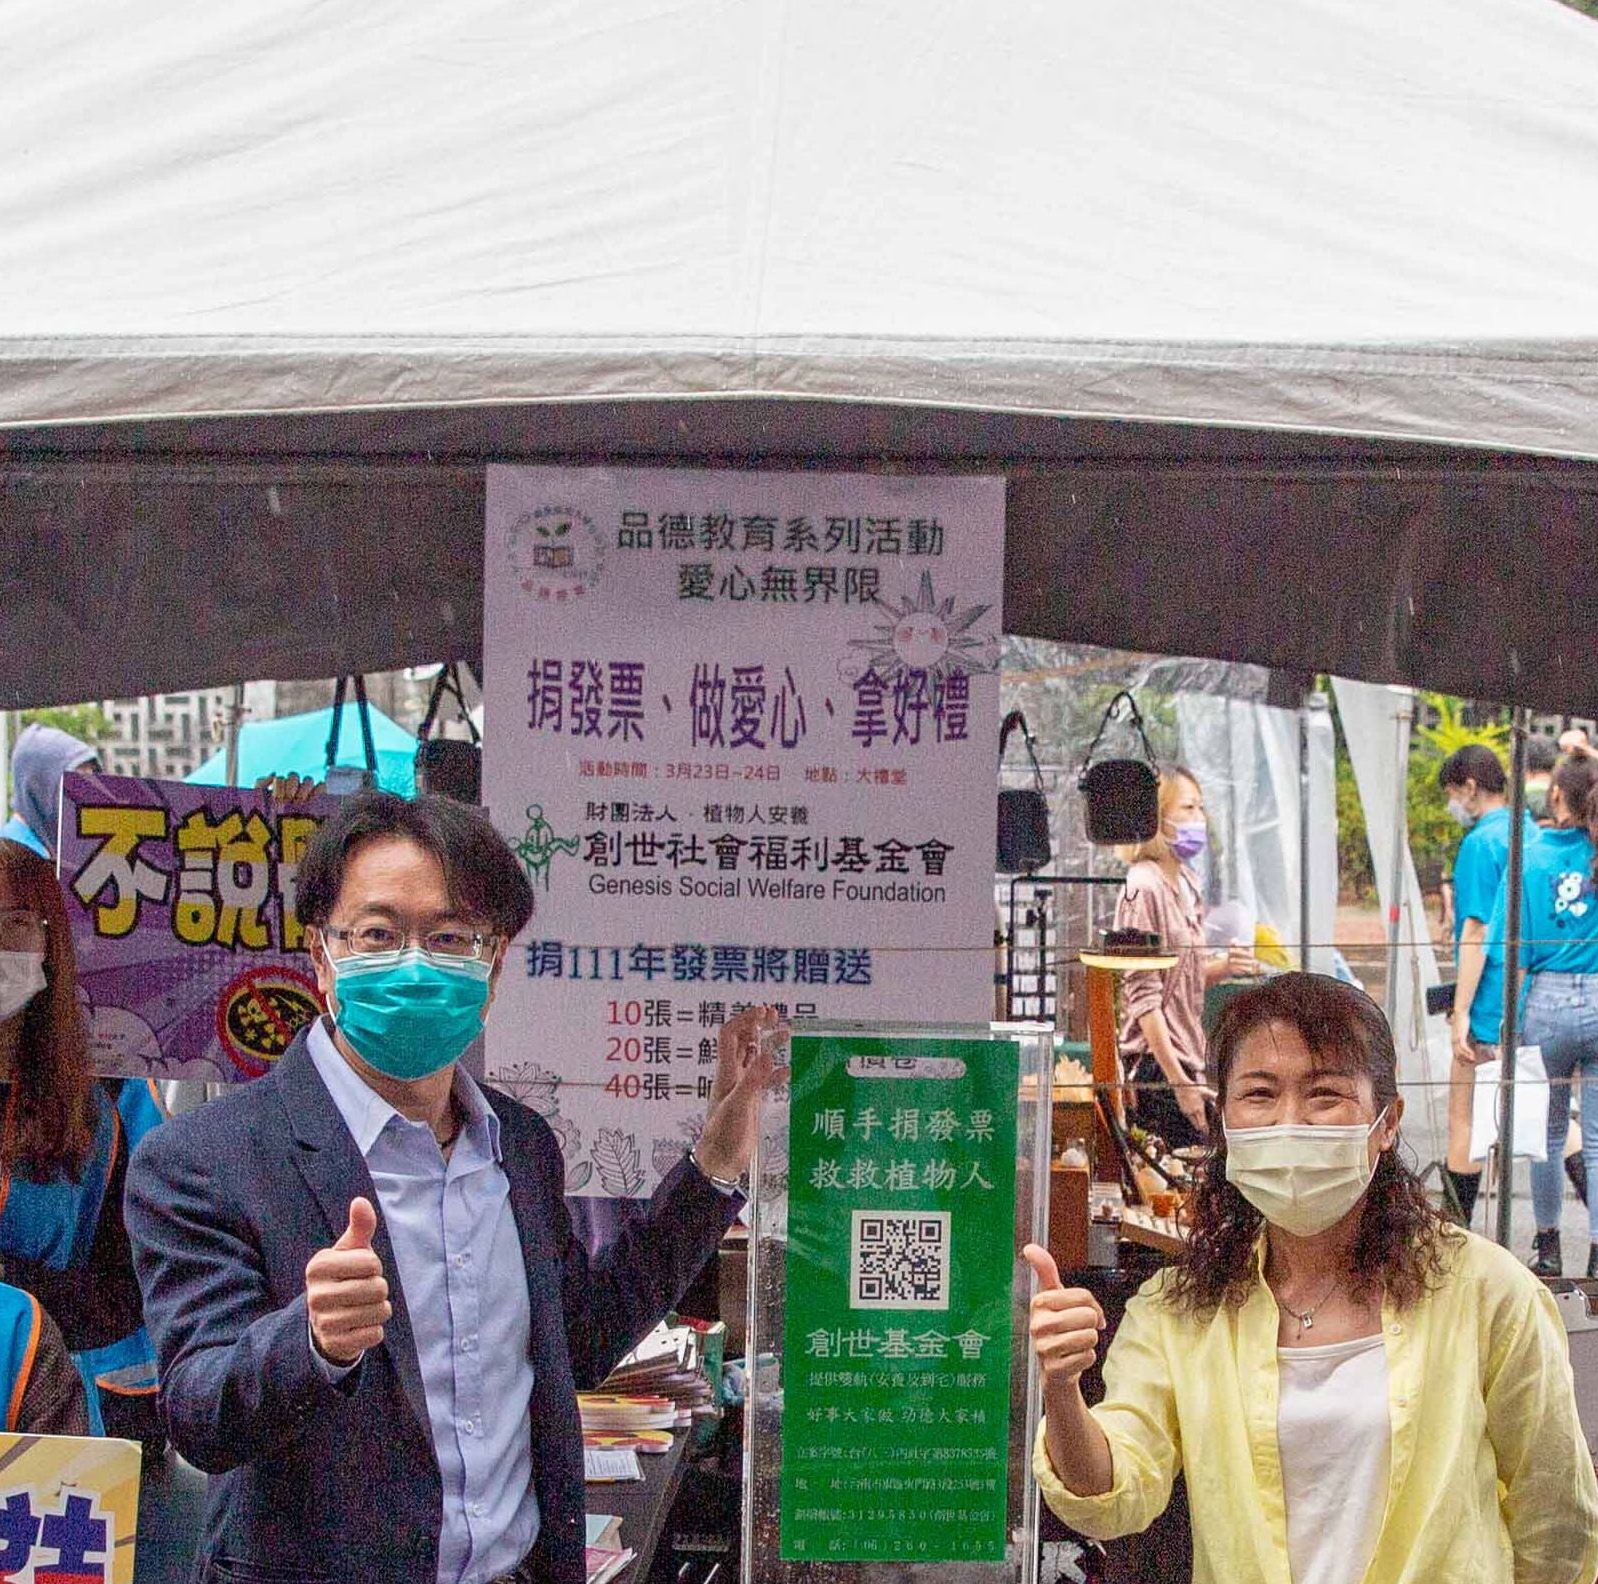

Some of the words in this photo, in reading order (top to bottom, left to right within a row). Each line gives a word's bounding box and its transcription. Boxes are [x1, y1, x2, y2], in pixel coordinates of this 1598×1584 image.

[617, 512, 944, 557] 品德教育系列活動
[678, 565, 882, 605] 愛心無界限
[527, 658, 971, 750] 捐發票、做愛心、拿好禮
[583, 830, 955, 877] 創世社會福利基金會
[588, 874, 672, 897] Genesis
[679, 876, 740, 898] Social
[747, 877, 825, 900] Welfare
[833, 879, 946, 903] Foundation
[527, 941, 873, 985] 捐111年發票將贈送
[811, 1106, 996, 1143] 順手捐發票
[809, 1156, 996, 1191] 救救植物人
[805, 1326, 991, 1360] 創世基金會
